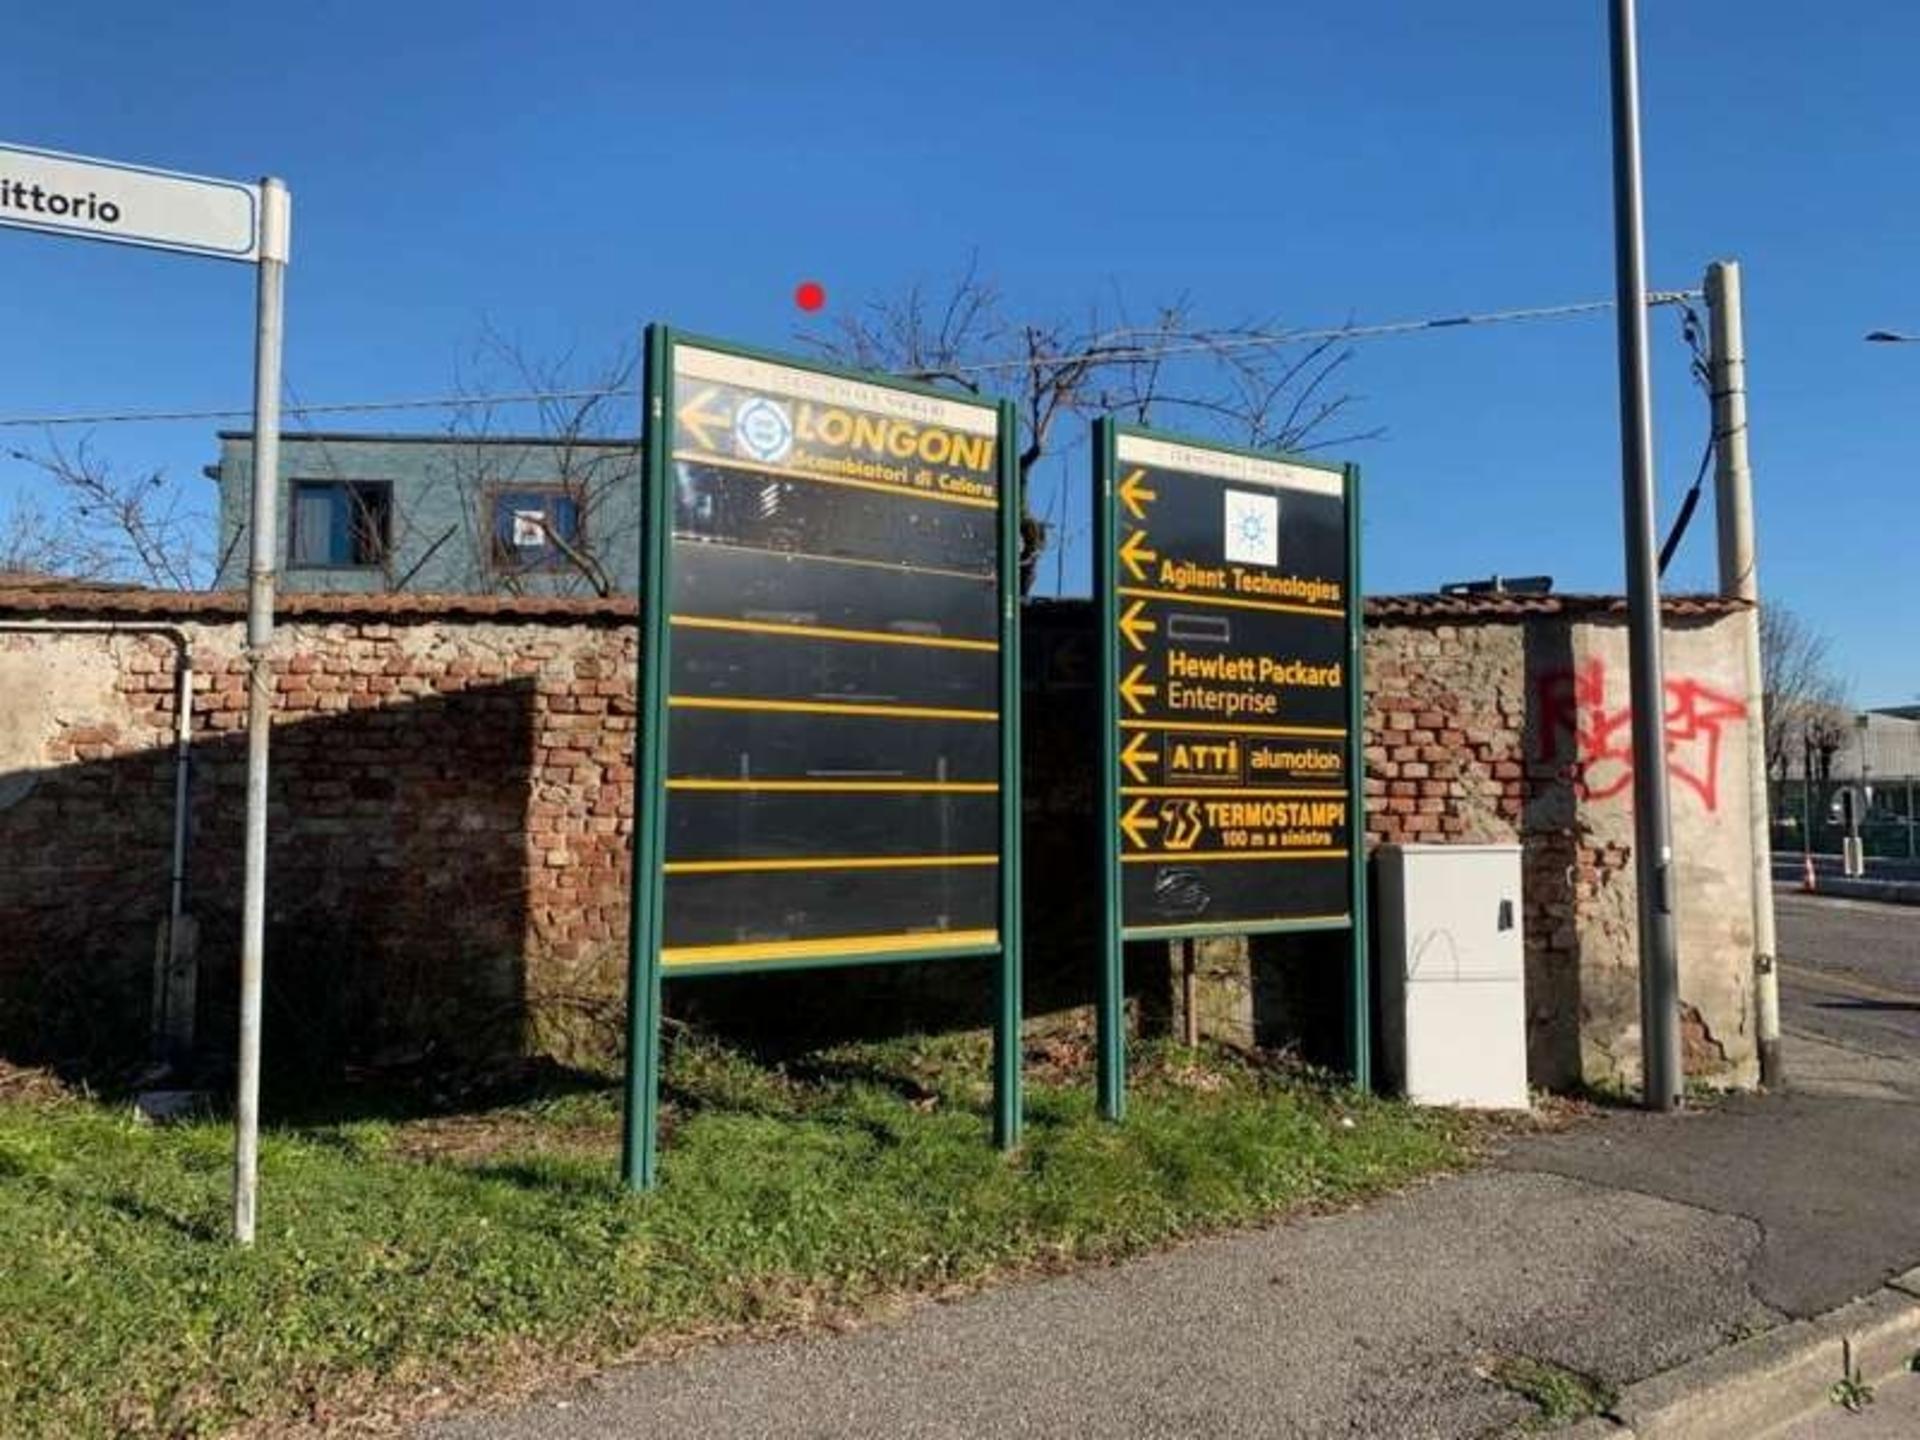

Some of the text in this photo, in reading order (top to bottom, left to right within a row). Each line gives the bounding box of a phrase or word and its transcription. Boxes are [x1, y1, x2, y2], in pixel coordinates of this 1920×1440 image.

[797, 403, 993, 471] LONGONI
[914, 472, 934, 488] di
[1160, 560, 1340, 603] Agilent Technologies
[1168, 651, 1341, 687] Hewlett Packard
[1168, 682, 1277, 717] Enterprise
[1251, 747, 1341, 769] alumotion
[1205, 803, 1345, 827] TERMOSTAMPI
[1222, 830, 1248, 846] 100
[1250, 834, 1265, 846] m
[1281, 830, 1332, 846] sinistra
